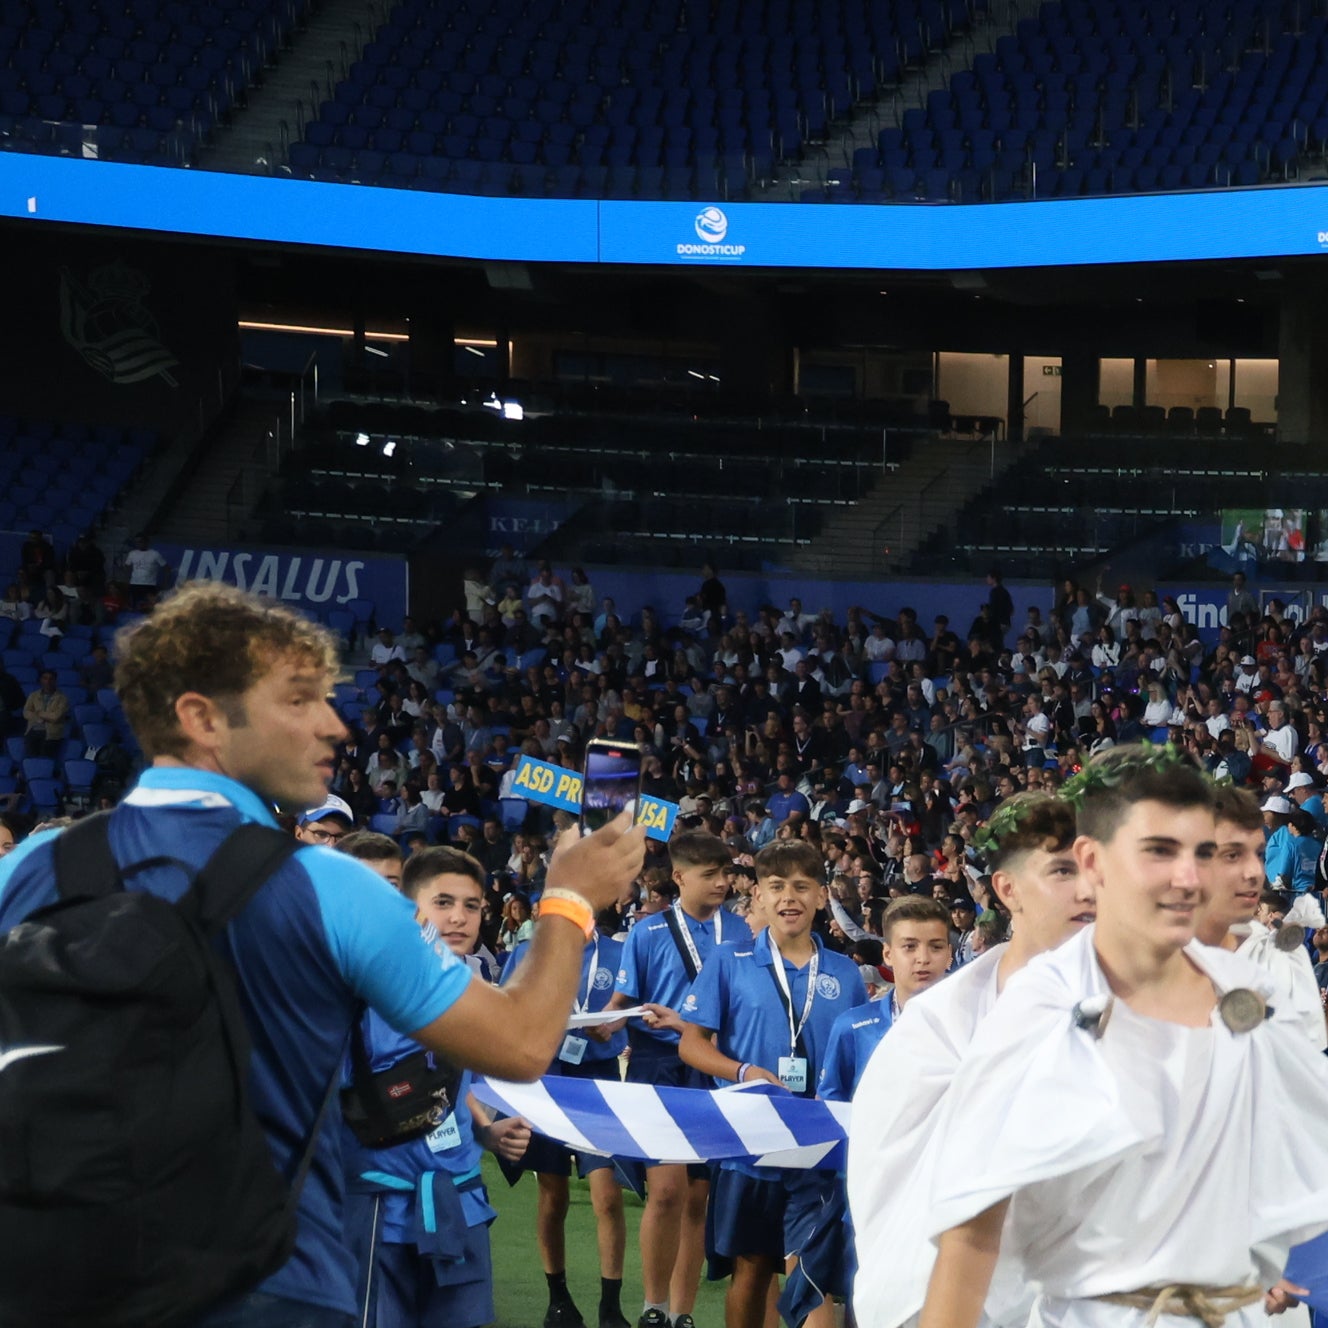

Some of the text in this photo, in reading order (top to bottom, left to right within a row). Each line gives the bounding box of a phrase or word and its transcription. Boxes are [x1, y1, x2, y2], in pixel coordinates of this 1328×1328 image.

[677, 244, 746, 256] DONOSTICUP
[174, 549, 365, 604] INSALUS
[515, 762, 555, 794] ASD
[780, 1074, 805, 1083] PLAYER
